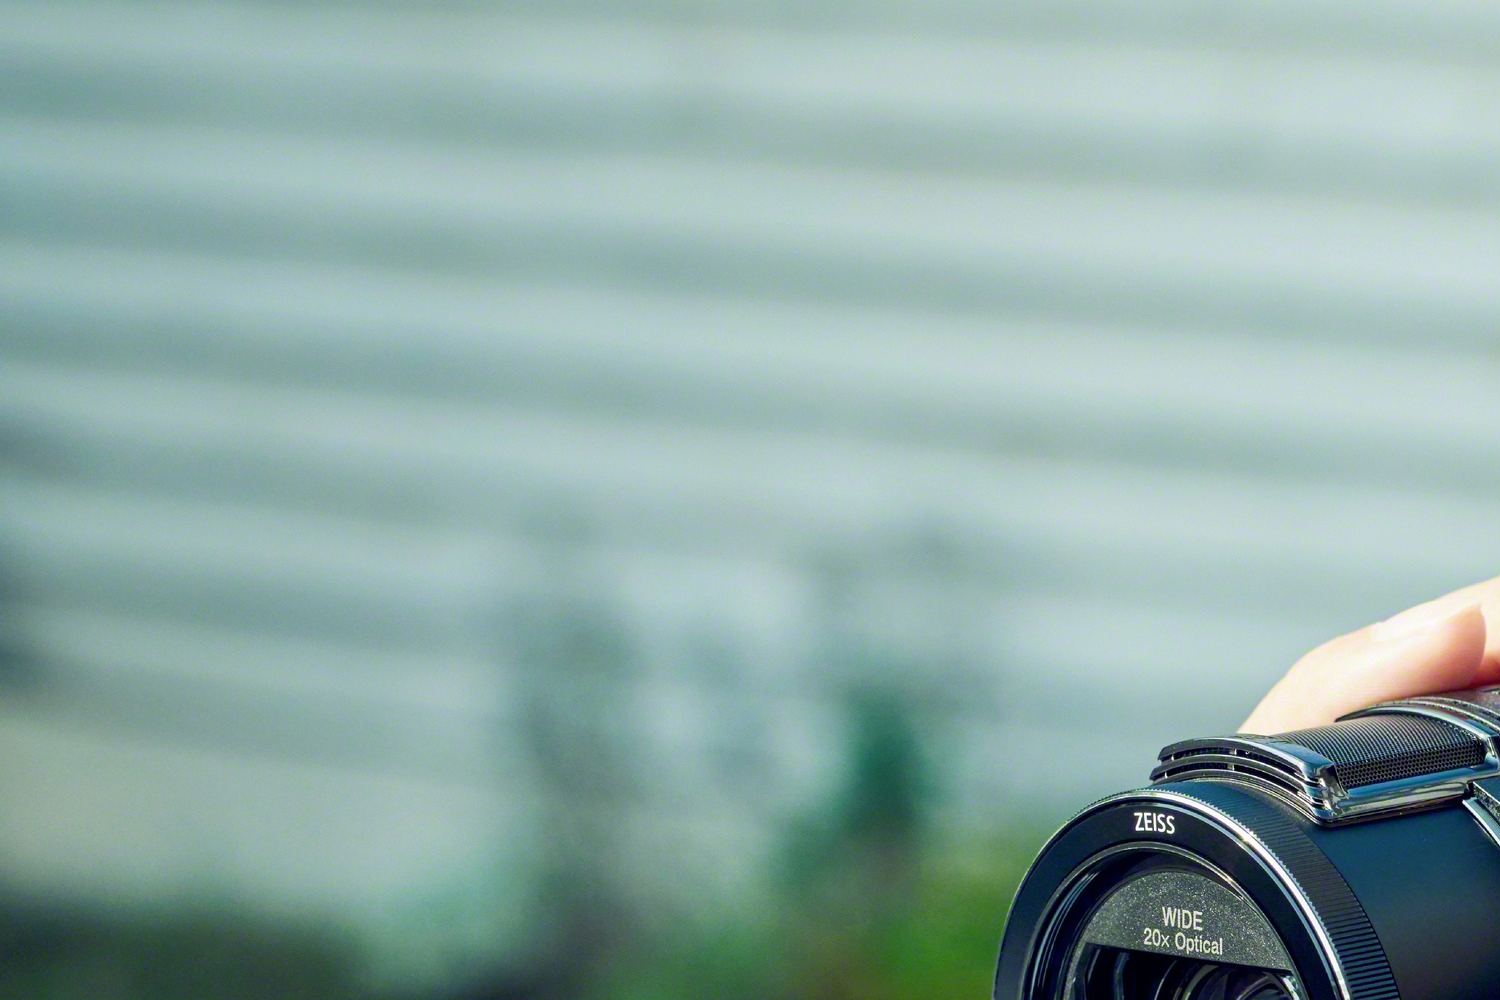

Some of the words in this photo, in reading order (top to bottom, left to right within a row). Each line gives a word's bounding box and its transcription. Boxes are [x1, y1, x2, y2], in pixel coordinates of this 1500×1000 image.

[1133, 811, 1176, 835] ZEISS
[1161, 906, 1203, 931] WIDE
[1143, 928, 1170, 949] 20x
[1174, 933, 1223, 956] Optical
